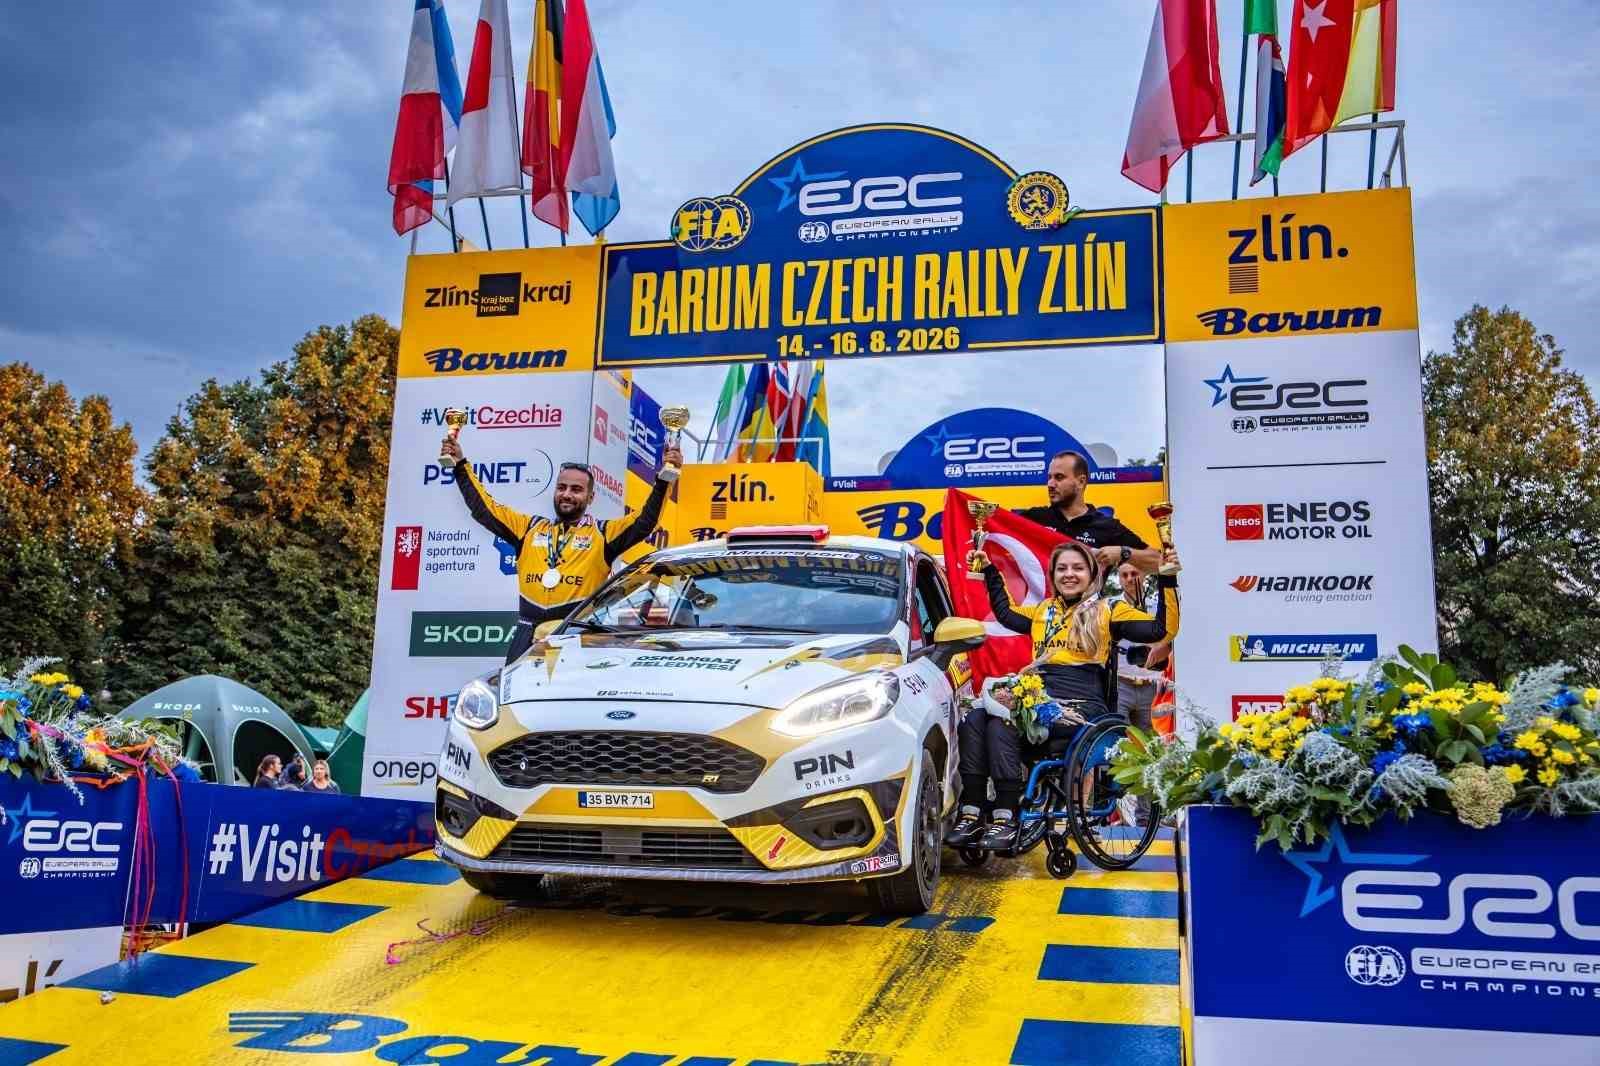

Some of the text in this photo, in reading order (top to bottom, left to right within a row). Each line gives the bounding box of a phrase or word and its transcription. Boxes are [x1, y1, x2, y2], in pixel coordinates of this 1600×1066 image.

[800, 172, 962, 216] ERC
[835, 216, 958, 230] EUROPEAN RALLY
[835, 227, 959, 241] CHAMPIONSHIP
[1228, 213, 1348, 264] zlín.
[523, 280, 572, 304] kraj
[629, 233, 1127, 337] BARUM CZECH RALLY ZLÍN
[1197, 306, 1382, 335] Barum
[777, 334, 809, 356] 14.
[830, 332, 863, 354] 16.
[871, 330, 892, 352] 8.
[897, 326, 960, 351] 2026
[424, 347, 567, 372] Barum
[1231, 380, 1368, 410] ERC
[1262, 413, 1367, 424] EUROPEAN RALLY
[944, 436, 1045, 460] ERC
[712, 474, 775, 502] zlín.
[1228, 518, 1260, 527] ENEOS
[1267, 500, 1371, 524] ENEOS
[428, 530, 471, 541] Národní
[1268, 525, 1373, 540] MOTOR OIL
[427, 545, 480, 558] sportovní
[425, 561, 476, 574] agentura
[526, 573, 584, 586] BINCE
[1285, 593, 1373, 604] driving emotion
[1271, 643, 1365, 654] MICHELIN
[405, 697, 448, 718] SH
[447, 742, 472, 771] PIN
[793, 750, 855, 781] PIN
[373, 761, 436, 784] onep
[805, 774, 851, 790] DRINKS
[588, 794, 602, 805] 35
[605, 794, 629, 805] BVR
[631, 795, 651, 805] 714
[23, 819, 123, 852] ERC
[1419, 956, 1565, 973] EUROPEAN
